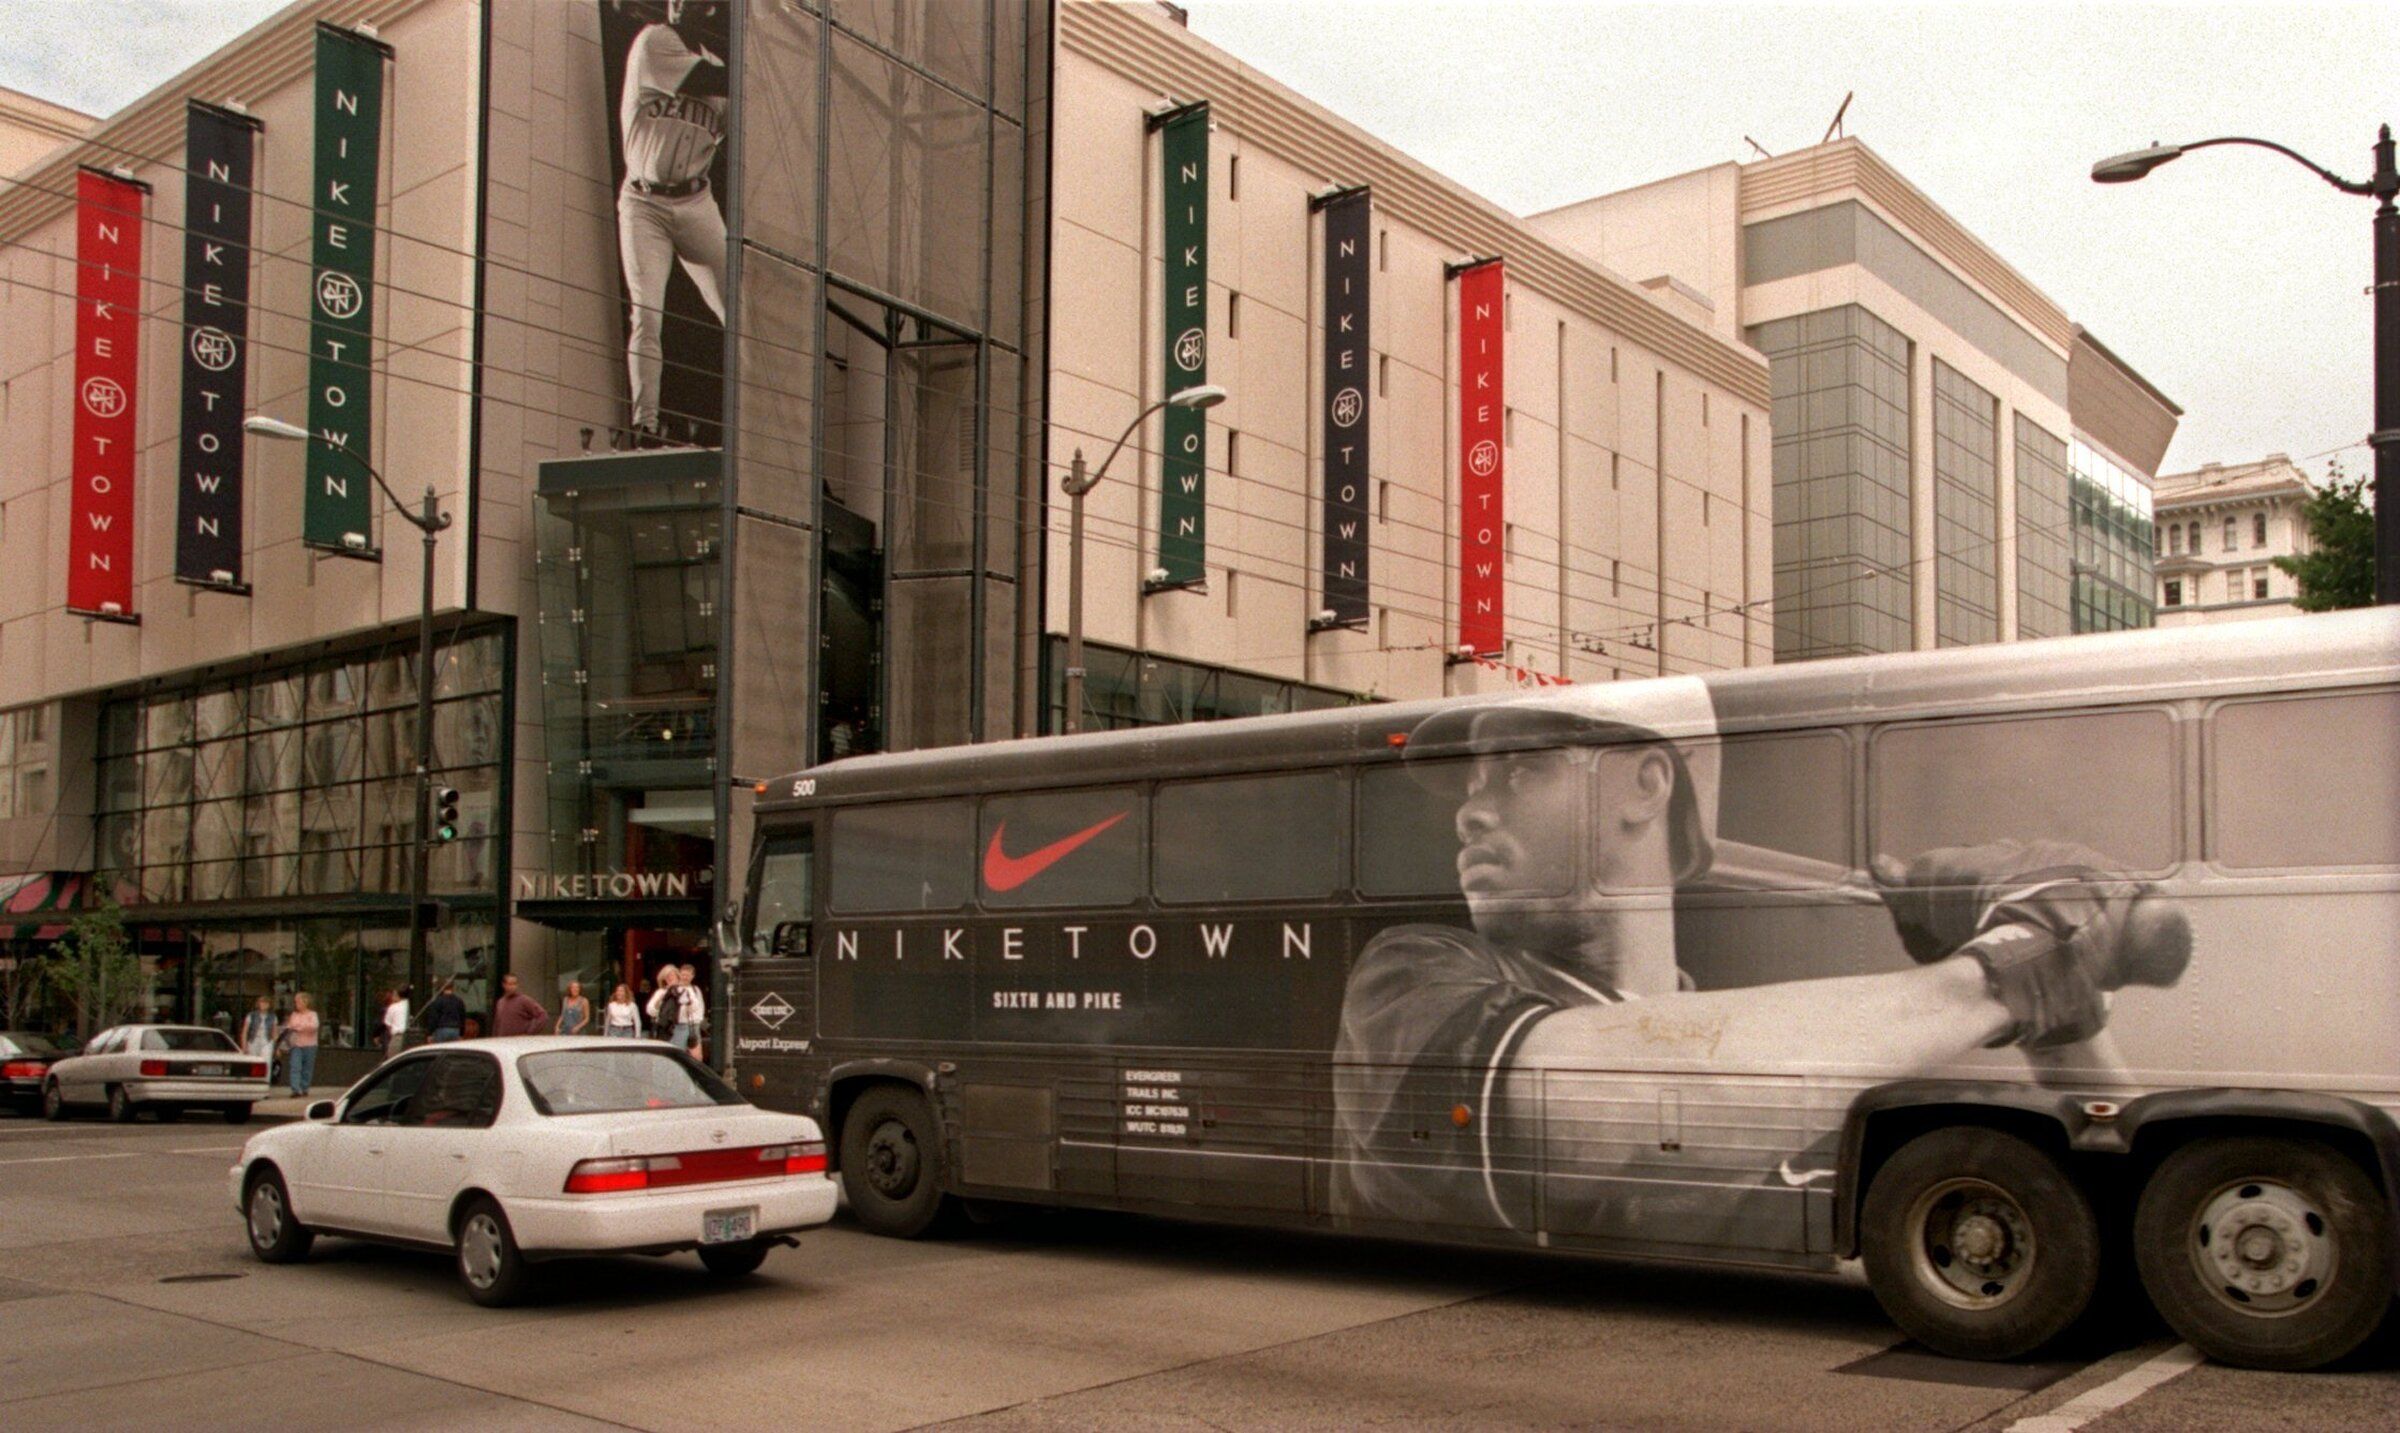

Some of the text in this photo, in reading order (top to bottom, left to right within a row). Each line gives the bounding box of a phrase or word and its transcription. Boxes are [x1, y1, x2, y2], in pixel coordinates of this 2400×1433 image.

[204, 159, 230, 306] NIKE
[329, 89, 358, 249] NIKE
[95, 223, 119, 358] NIKE
[1182, 163, 1199, 308] NIKE
[1339, 239, 1355, 370] NIKE
[1476, 303, 1491, 424] NIKE
[197, 391, 221, 538] TOWN
[323, 340, 348, 499] TOWN
[89, 436, 112, 572] TOWN
[1339, 446, 1357, 579] TOWN
[1476, 492, 1492, 615] TOWN
[792, 779, 816, 797] 500
[519, 872, 688, 899] NIKETOWN
[993, 991, 1122, 1009] SIXTH AND PIKE
[1125, 1070, 1182, 1082] EVERGREEN
[1126, 1087, 1159, 1099] TRAILS
